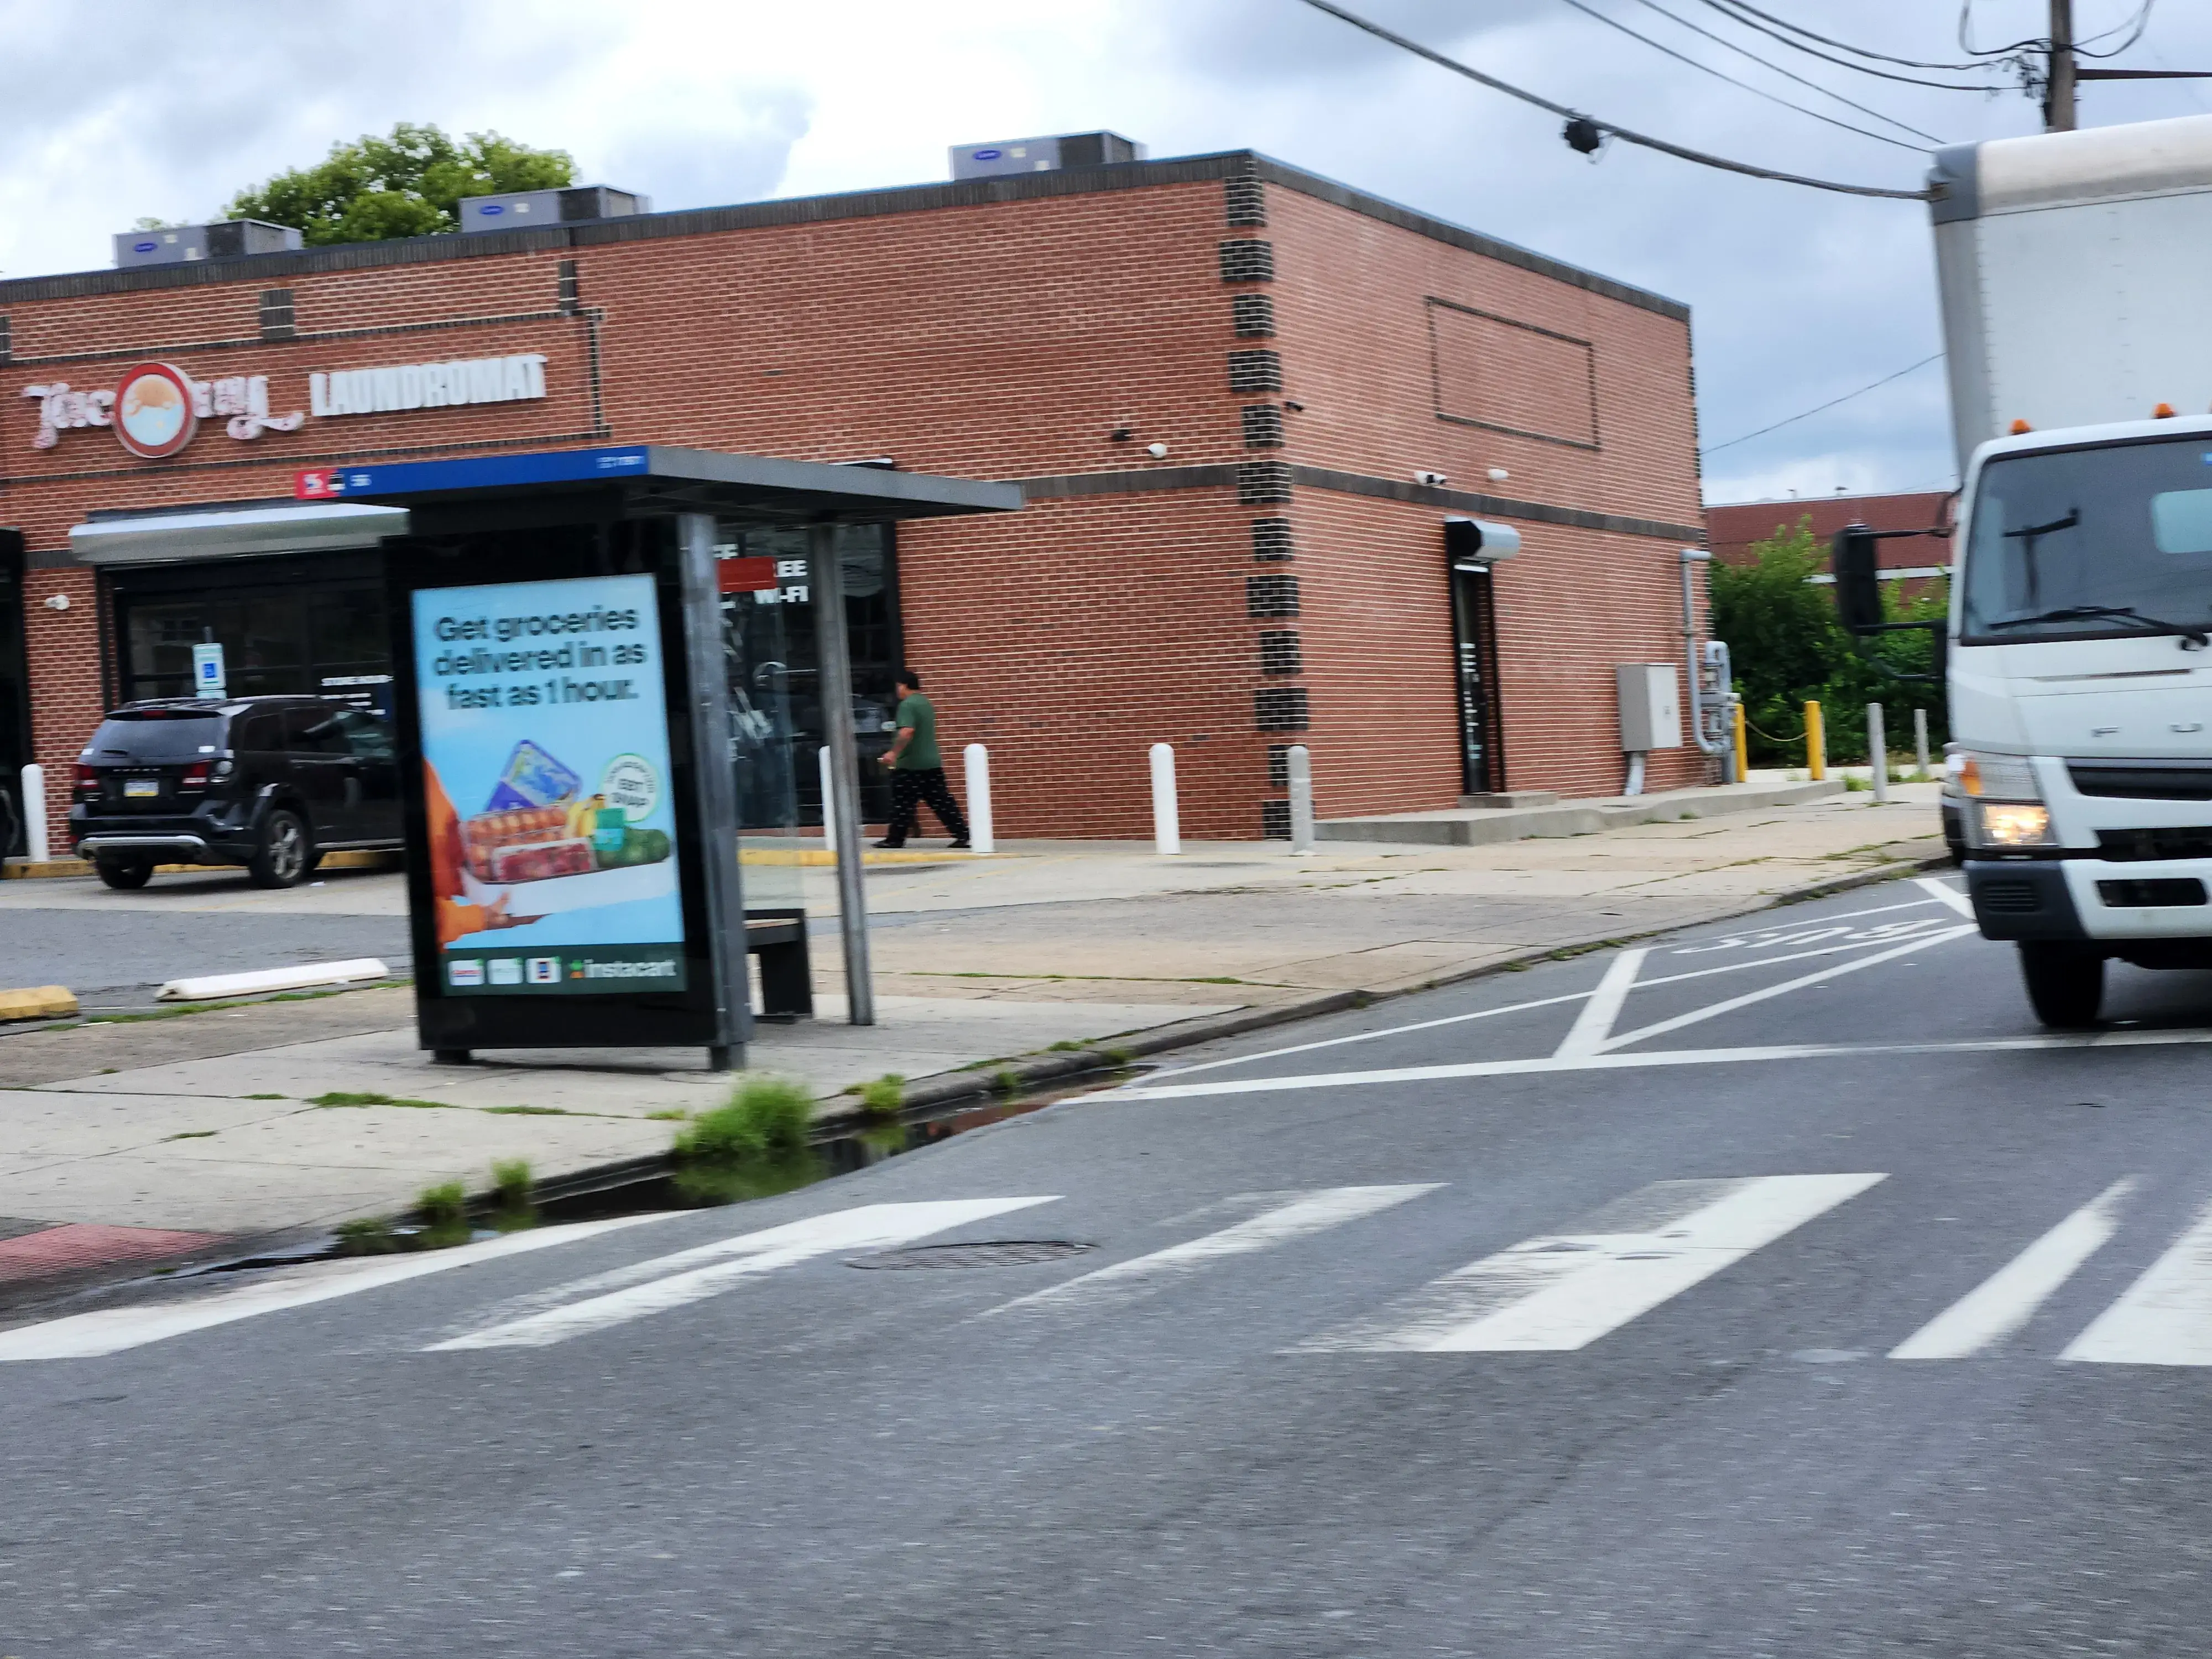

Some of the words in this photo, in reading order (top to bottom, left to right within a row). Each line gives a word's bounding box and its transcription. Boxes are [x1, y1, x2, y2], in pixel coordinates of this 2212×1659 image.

[309, 354, 547, 416] LAUNDROMAT
[436, 615, 489, 642] Get
[497, 604, 640, 643] groceries
[434, 640, 574, 676] delivered
[577, 640, 606, 668] in
[612, 643, 647, 665] as
[447, 682, 503, 709] fast
[507, 685, 542, 706] as
[544, 678, 559, 705] 1
[560, 676, 641, 703] hour.
[585, 959, 677, 978] instacart
